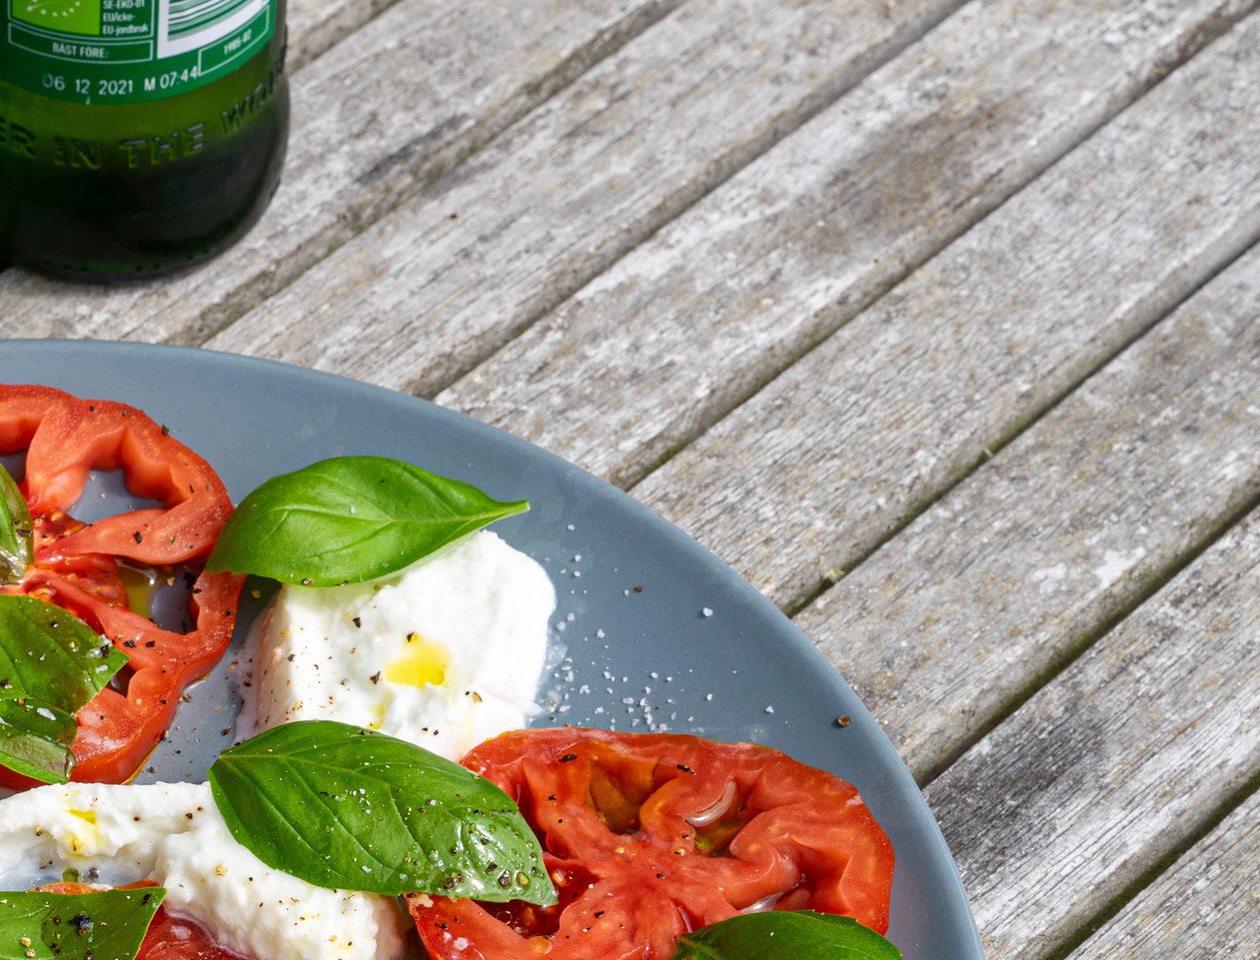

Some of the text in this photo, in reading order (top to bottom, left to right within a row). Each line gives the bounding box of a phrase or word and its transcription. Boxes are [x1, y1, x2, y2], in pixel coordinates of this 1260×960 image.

[52, 42, 109, 59] BÄST FÖRE:
[42, 65, 198, 95] 06 12 2021 M 07:44
[53, 136, 102, 170] IN
[119, 122, 206, 168] THE
